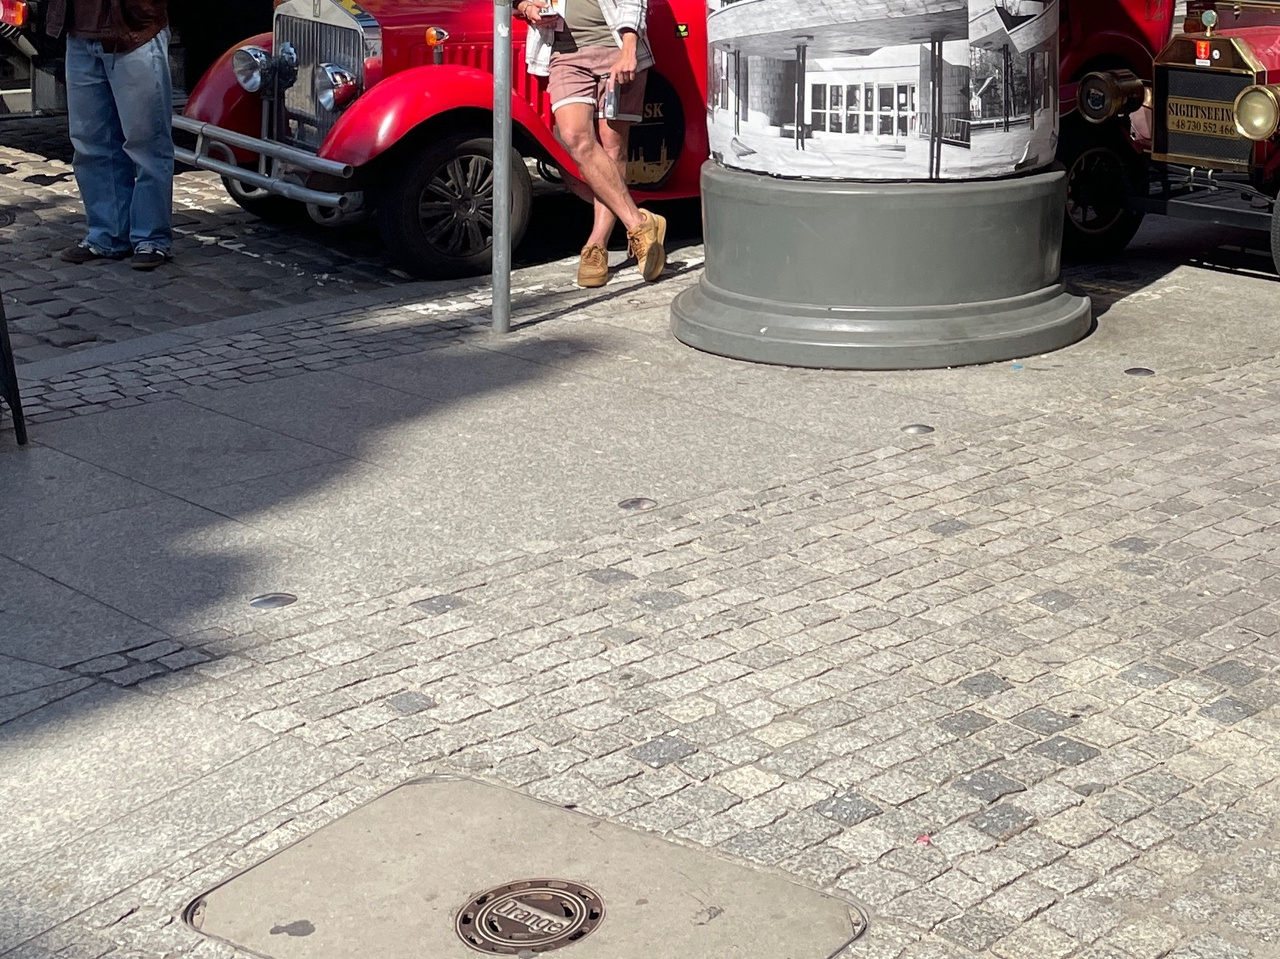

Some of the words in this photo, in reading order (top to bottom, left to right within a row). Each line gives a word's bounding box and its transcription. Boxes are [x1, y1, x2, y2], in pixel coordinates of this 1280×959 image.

[1187, 120, 1202, 132] 730
[1202, 122, 1217, 134] 552
[1219, 124, 1235, 136] 466
[495, 901, 564, 934] Orange
